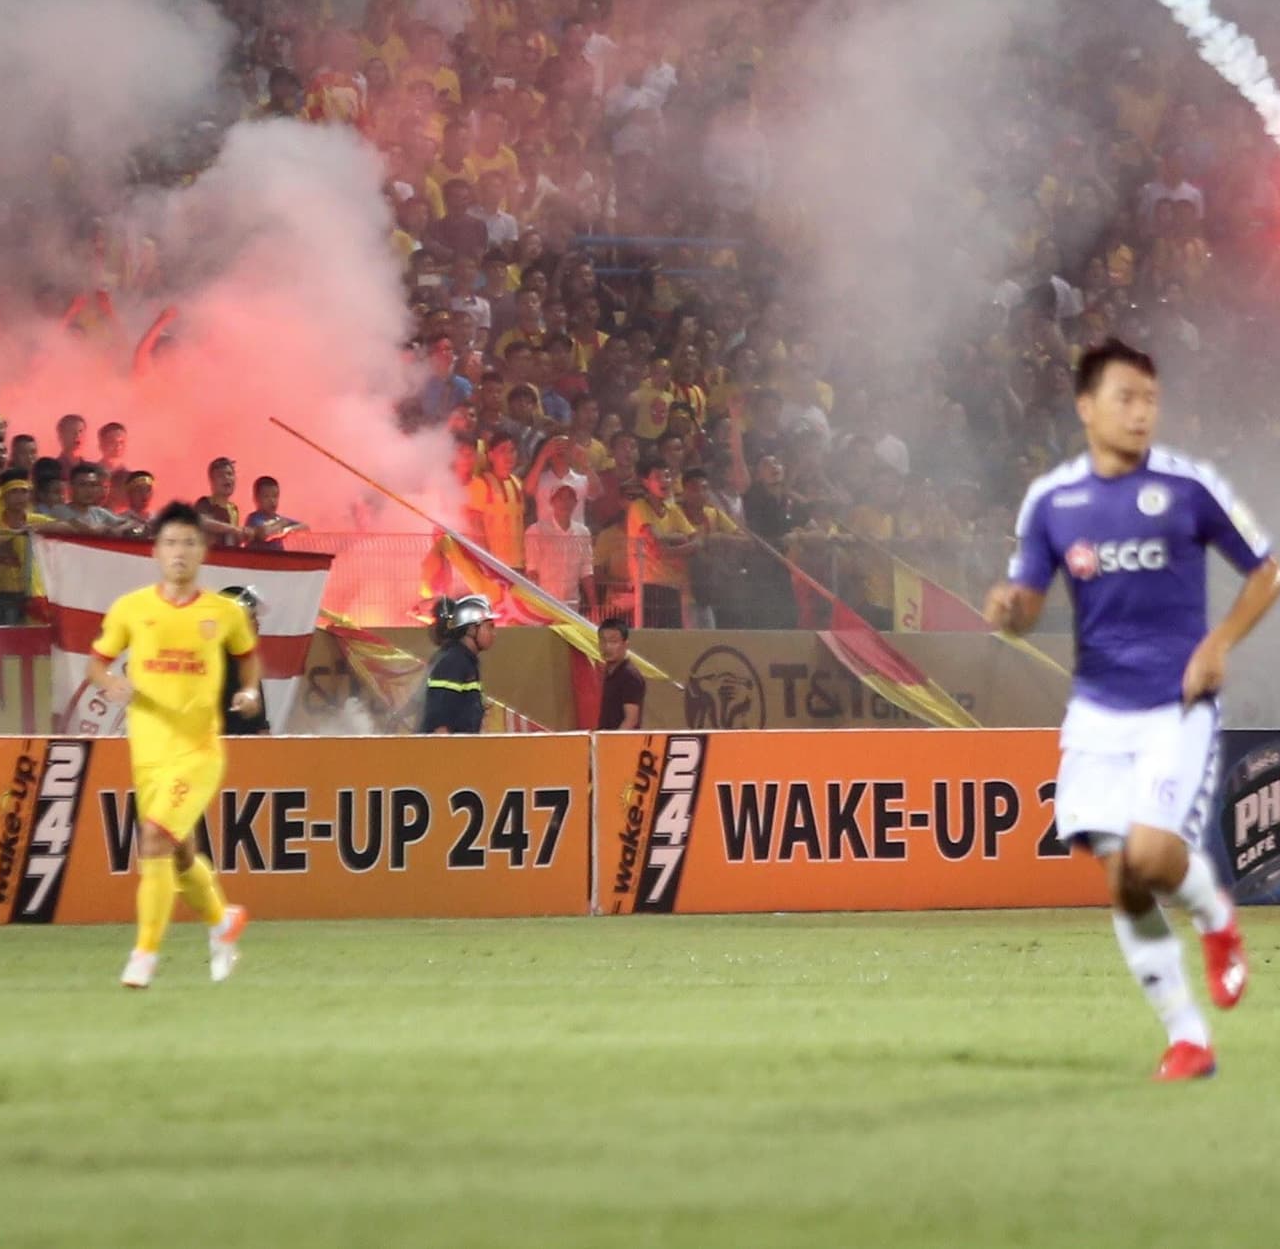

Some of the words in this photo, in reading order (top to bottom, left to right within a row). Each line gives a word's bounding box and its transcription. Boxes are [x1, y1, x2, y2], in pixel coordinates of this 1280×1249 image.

[1098, 540, 1166, 573] SCG
[22, 742, 87, 915] 247
[445, 786, 572, 870] 247
[645, 736, 703, 903] 247
[715, 779, 1021, 863] WAKE-UP
